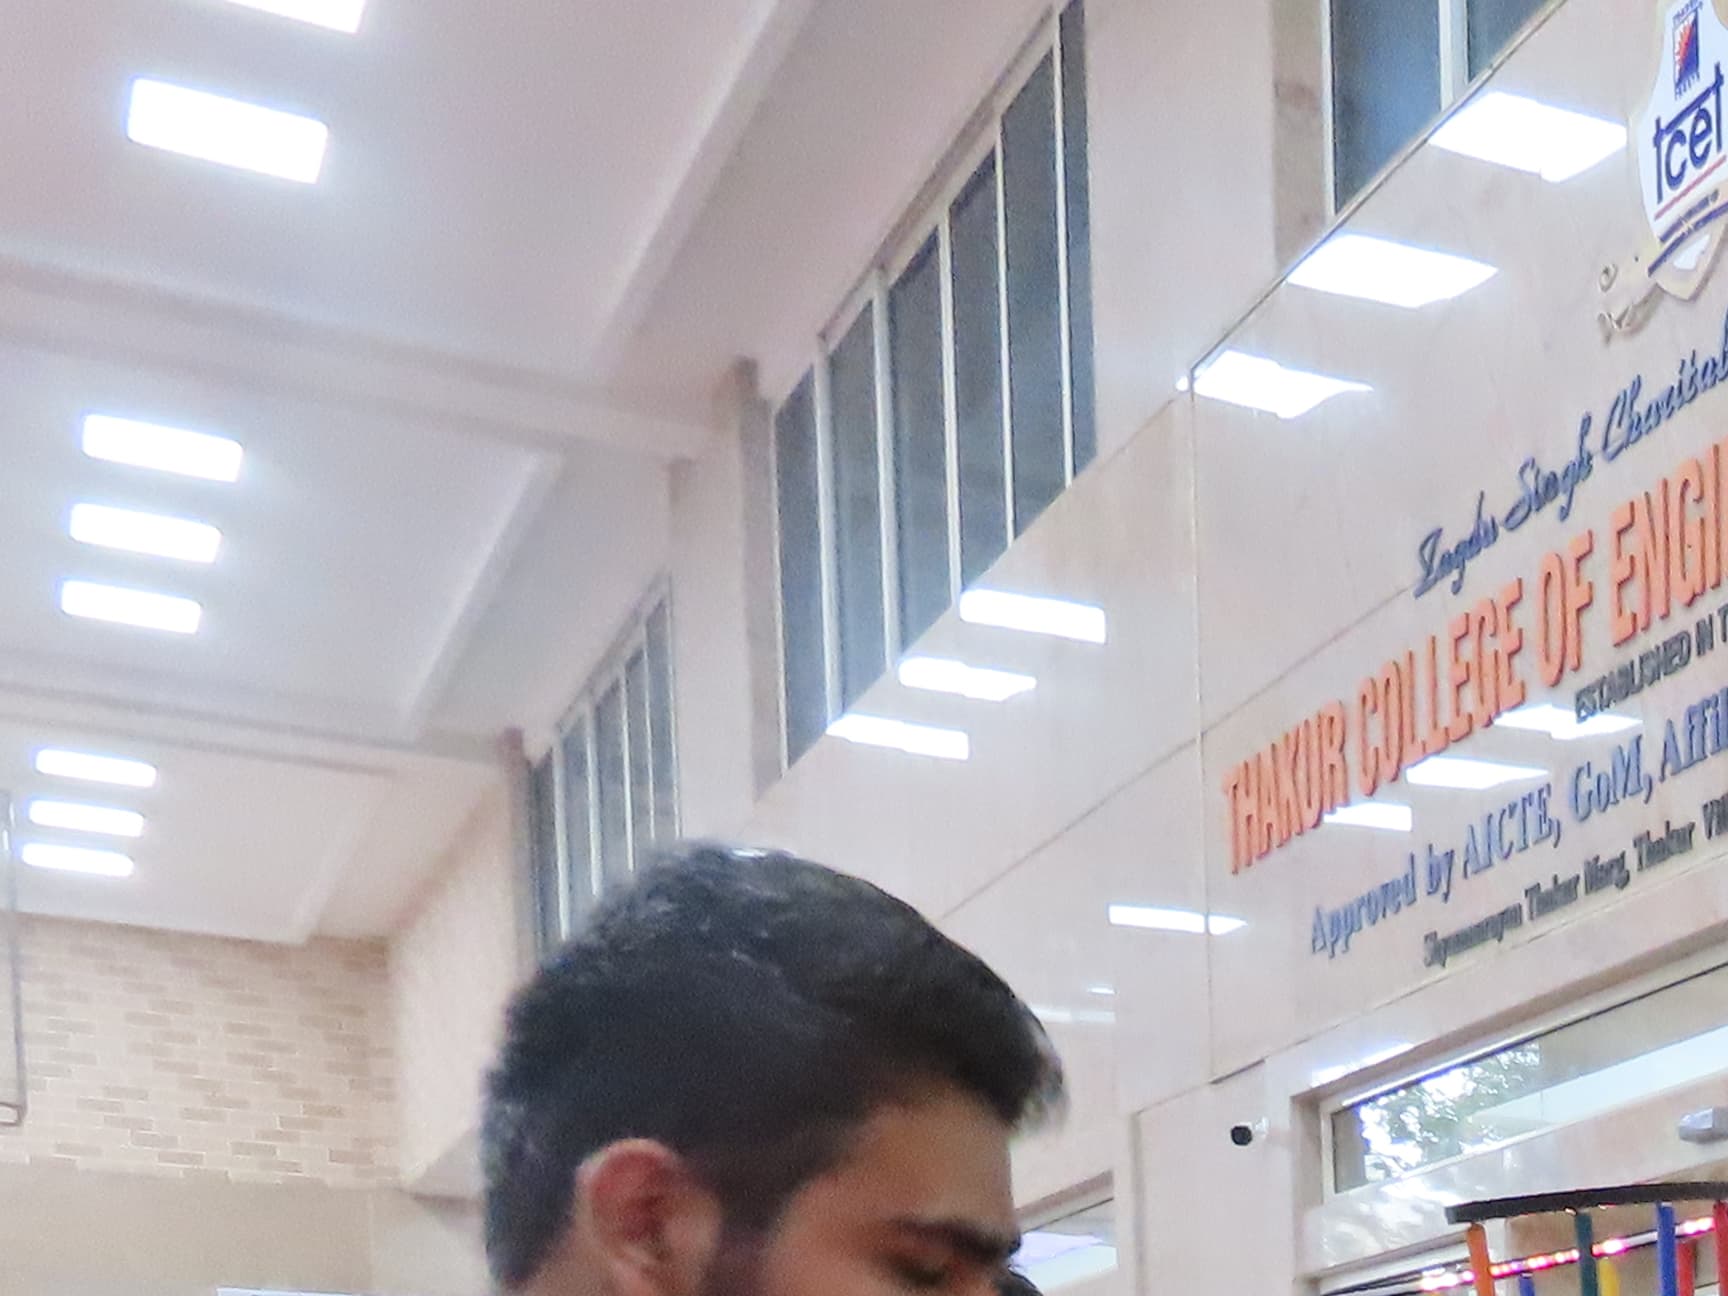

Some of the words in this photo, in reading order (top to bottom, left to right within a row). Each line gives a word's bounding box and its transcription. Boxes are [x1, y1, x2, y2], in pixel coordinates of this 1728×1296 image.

[1504, 411, 1594, 530] Singh
[1222, 699, 1349, 875] THAKUR
[1355, 576, 1527, 797] COLLEGE
[1536, 529, 1594, 688] OF
[1574, 630, 1692, 723] ESTABLISHED
[1695, 614, 1715, 657] IN
[1311, 852, 1417, 960] Approved
[1426, 843, 1456, 902] by
[1462, 782, 1563, 880] AICTE,
[1569, 733, 1655, 823] GoM,
